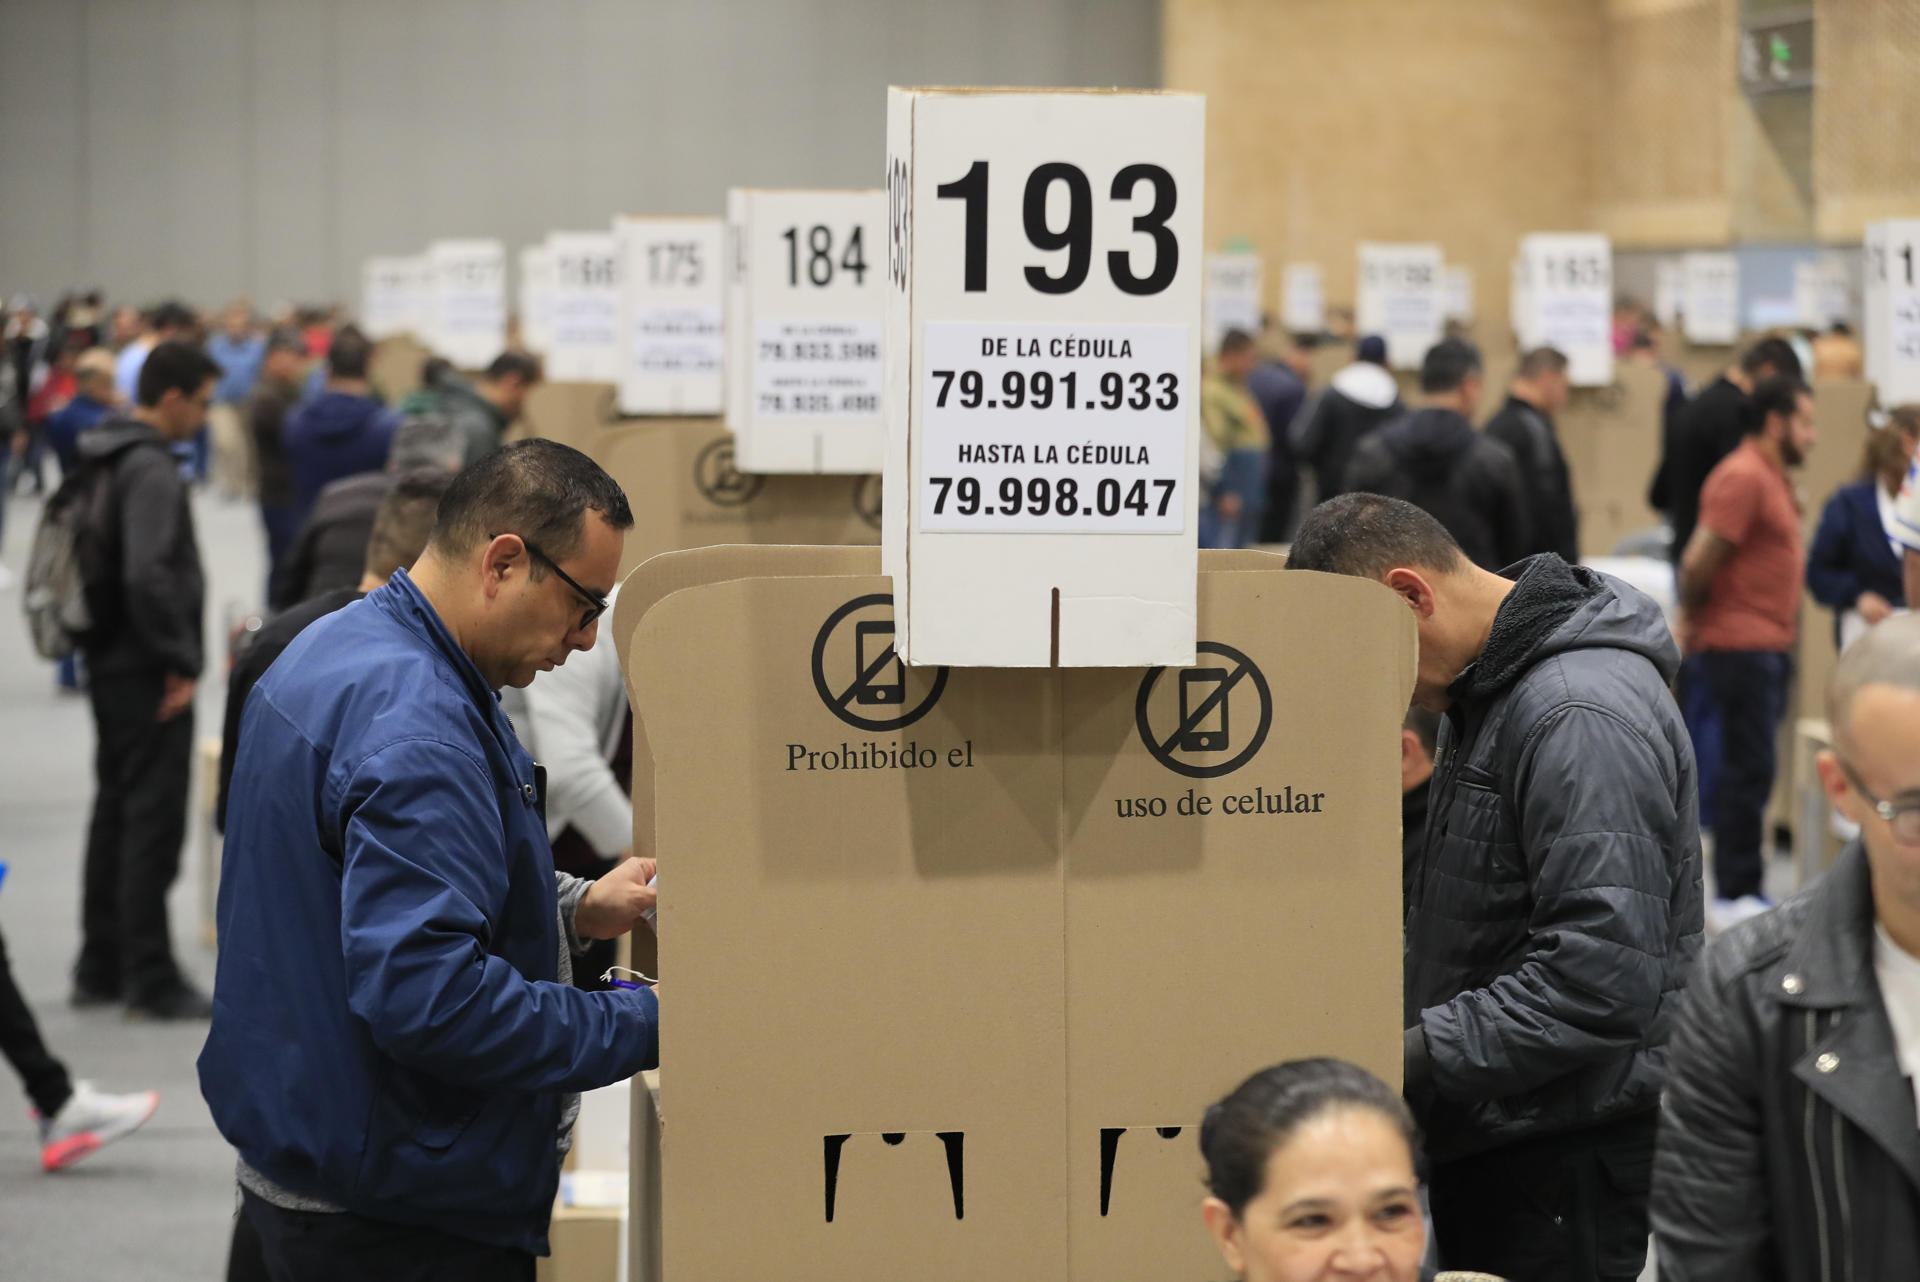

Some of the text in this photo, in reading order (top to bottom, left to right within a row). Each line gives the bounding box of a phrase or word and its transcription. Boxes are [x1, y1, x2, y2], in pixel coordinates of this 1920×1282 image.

[887, 154, 908, 293] 193
[937, 161, 1179, 296] 193
[648, 241, 705, 287] 175
[782, 225, 868, 287] 184
[982, 334, 1132, 358] DE LA CÉDULA
[932, 370, 1179, 411] 79.991.933
[958, 441, 1149, 465] HASTA LA CÉDULA
[929, 477, 1176, 517] 79.998.047
[785, 741, 975, 771] Prohibido el
[1114, 785, 1325, 818] uso de celular
